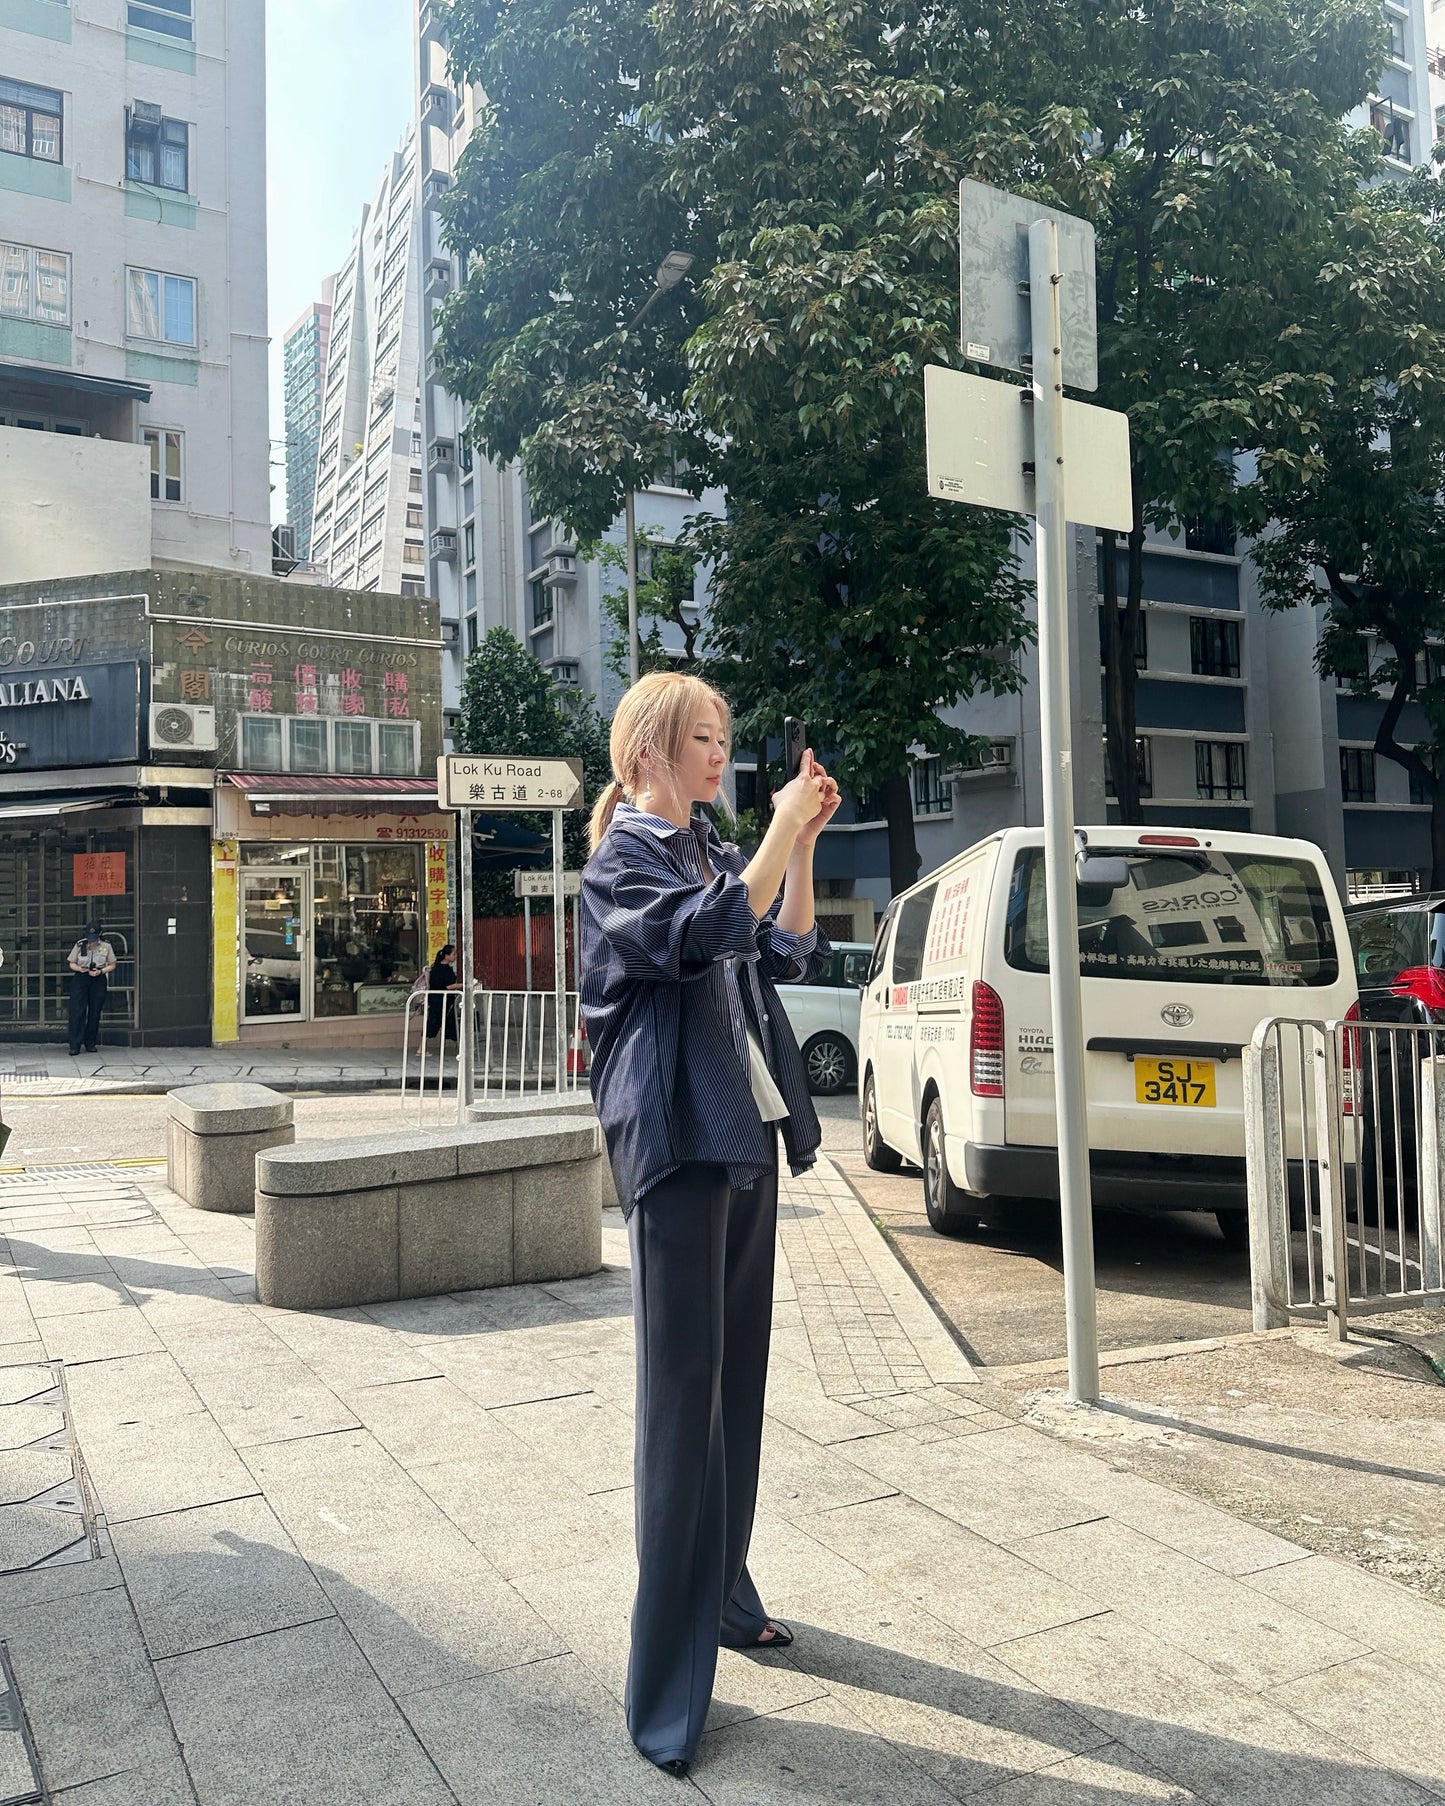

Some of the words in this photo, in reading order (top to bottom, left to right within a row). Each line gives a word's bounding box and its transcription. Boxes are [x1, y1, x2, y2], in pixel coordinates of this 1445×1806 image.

[224, 636, 289, 658] CURIOS
[297, 642, 353, 665] COURT
[358, 647, 418, 668] CURIOS
[250, 661, 409, 694] 高價收購
[453, 762, 479, 776] Lok
[483, 763, 502, 776] Ku
[506, 764, 542, 777] Road
[469, 783, 528, 801] 樂古道
[537, 788, 563, 799] 2-68
[395, 828, 449, 840] 91312530
[530, 884, 554, 893] 樂古
[1158, 1061, 1192, 1083] SJ
[1144, 1080, 1206, 1104] 3417
